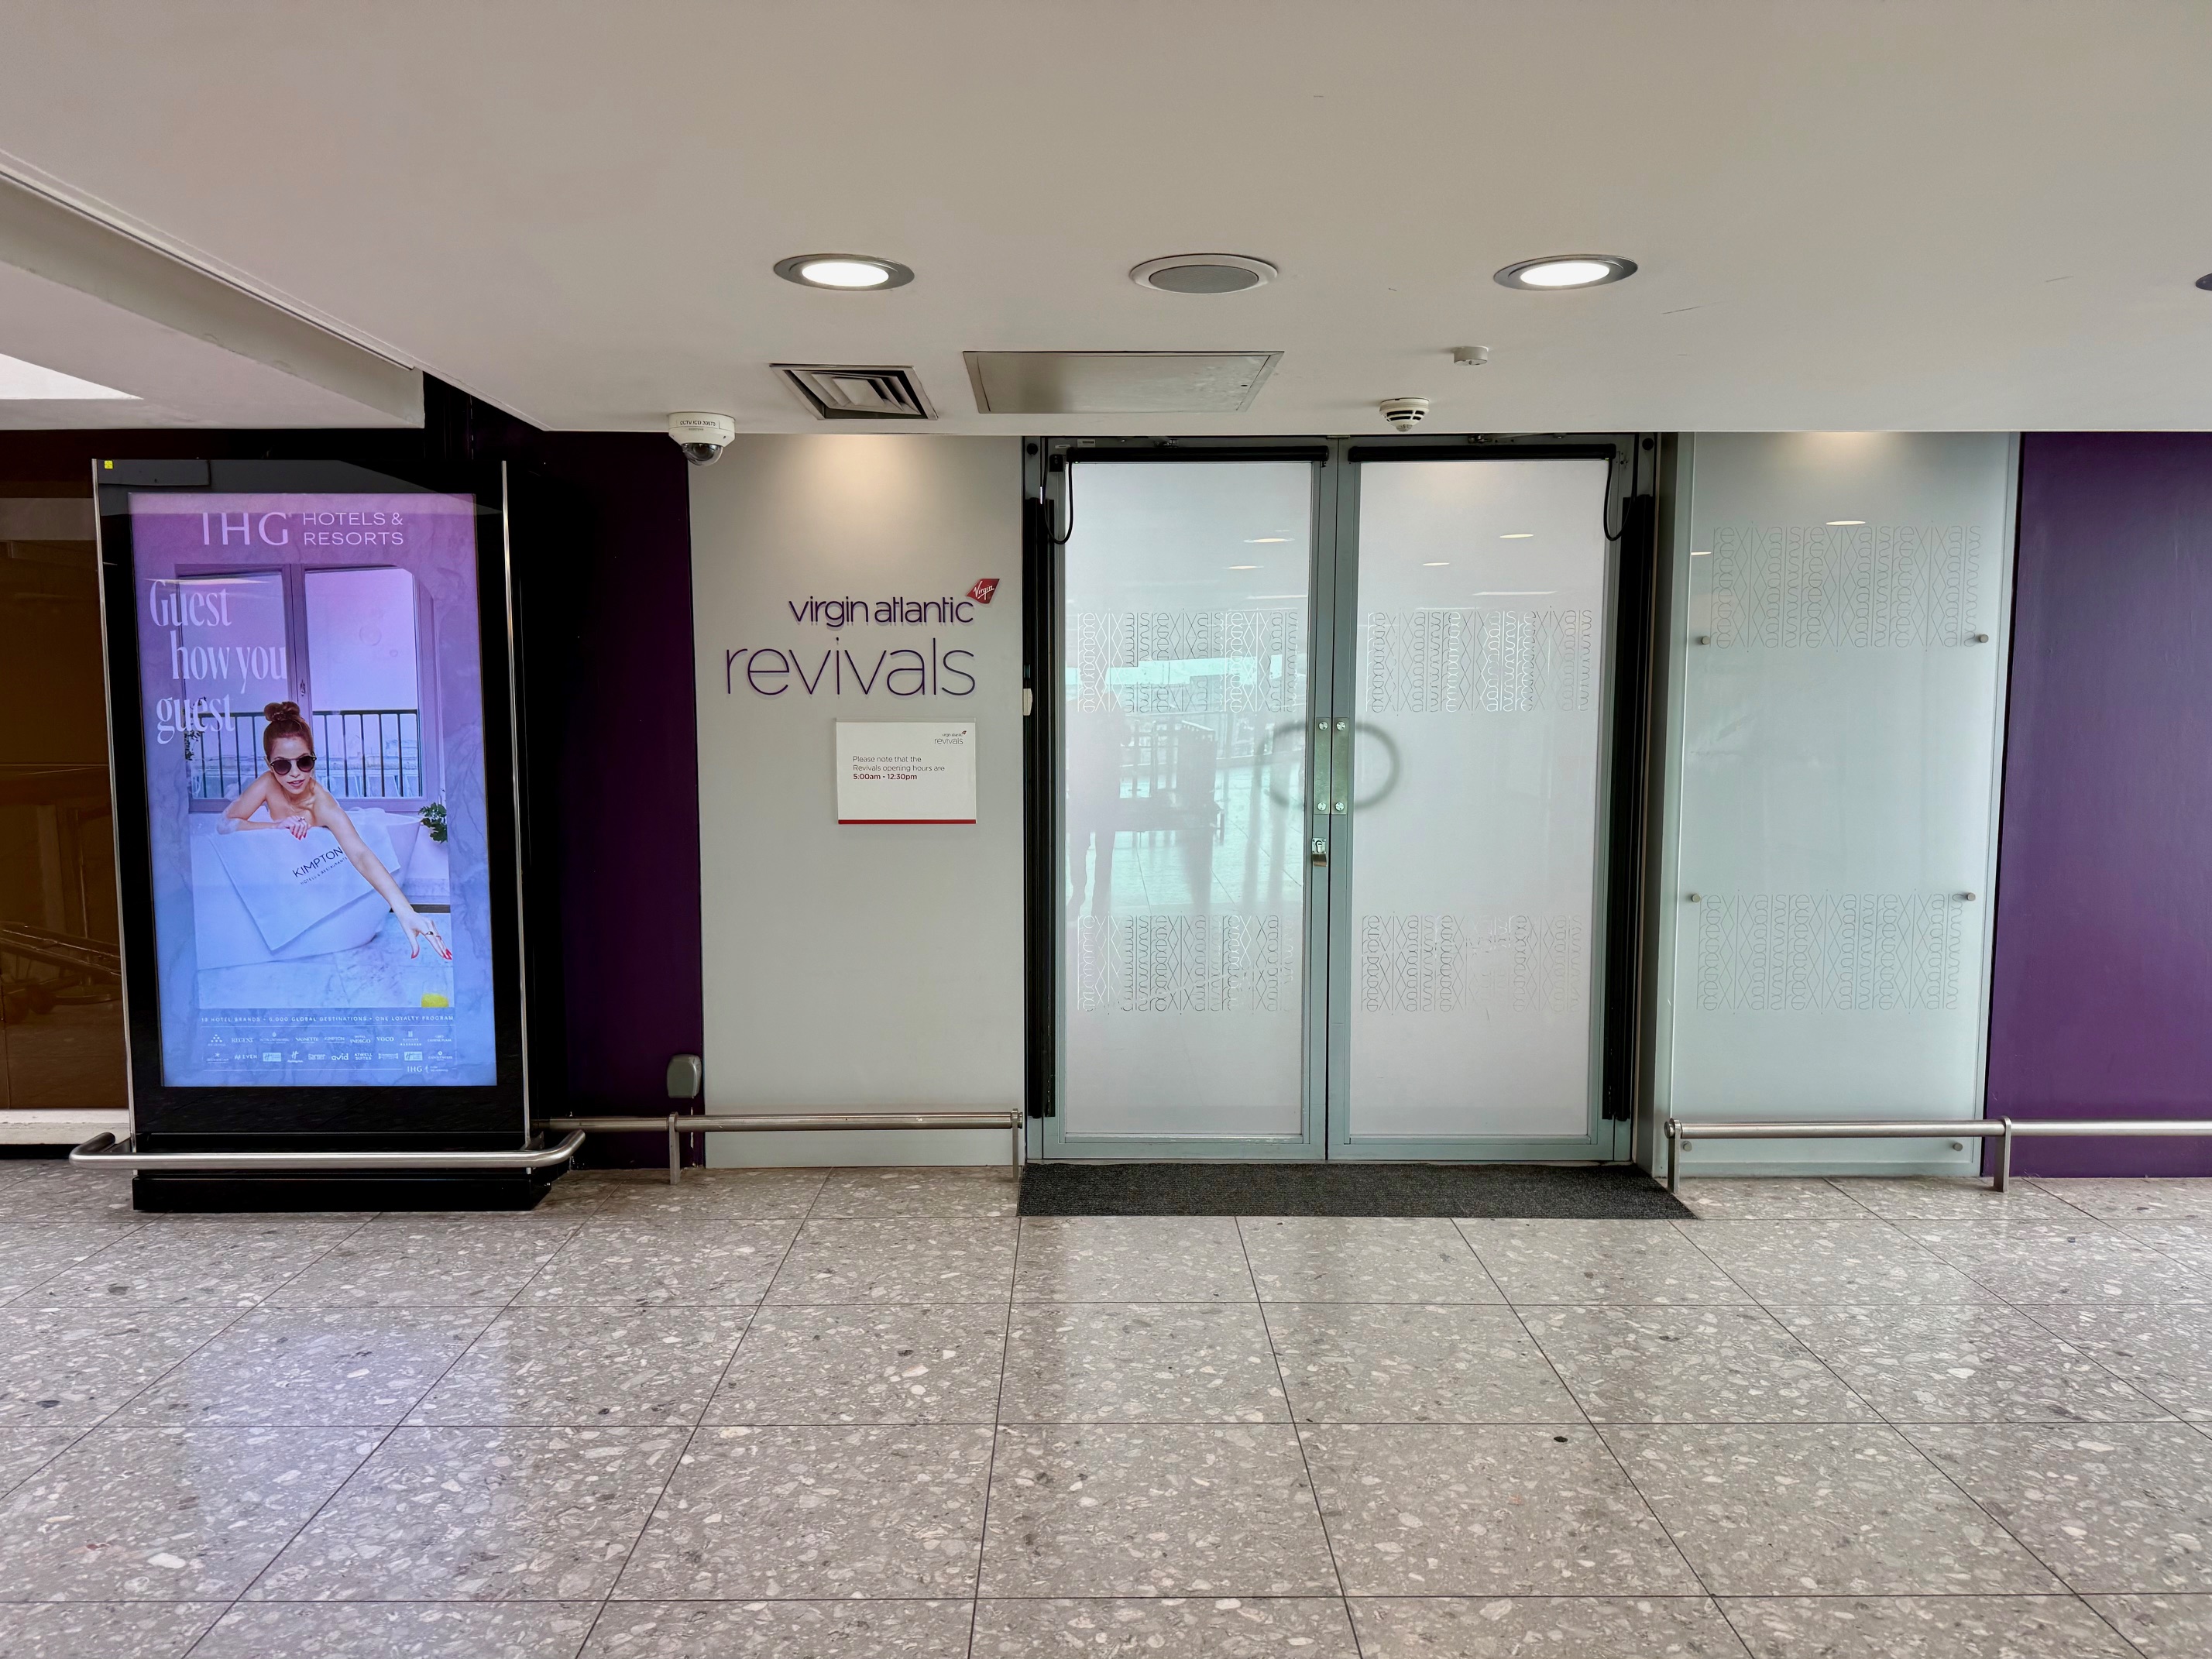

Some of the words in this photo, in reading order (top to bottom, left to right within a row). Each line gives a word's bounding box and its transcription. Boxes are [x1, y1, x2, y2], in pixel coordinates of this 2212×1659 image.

[202, 512, 289, 545] IHG
[302, 512, 386, 526] HOTELS
[391, 512, 404, 526] &
[304, 531, 404, 545] RESORTS
[149, 579, 232, 627] Guest
[973, 580, 995, 600] Virgin
[788, 596, 868, 627] virgin
[874, 596, 974, 623] atlantic
[170, 630, 232, 681] how
[237, 644, 288, 695] you
[726, 637, 976, 696] revivals
[156, 692, 235, 745] guest
[934, 737, 963, 745] revivals
[292, 846, 344, 878] KIMPTON
[331, 1053, 349, 1061] avid
